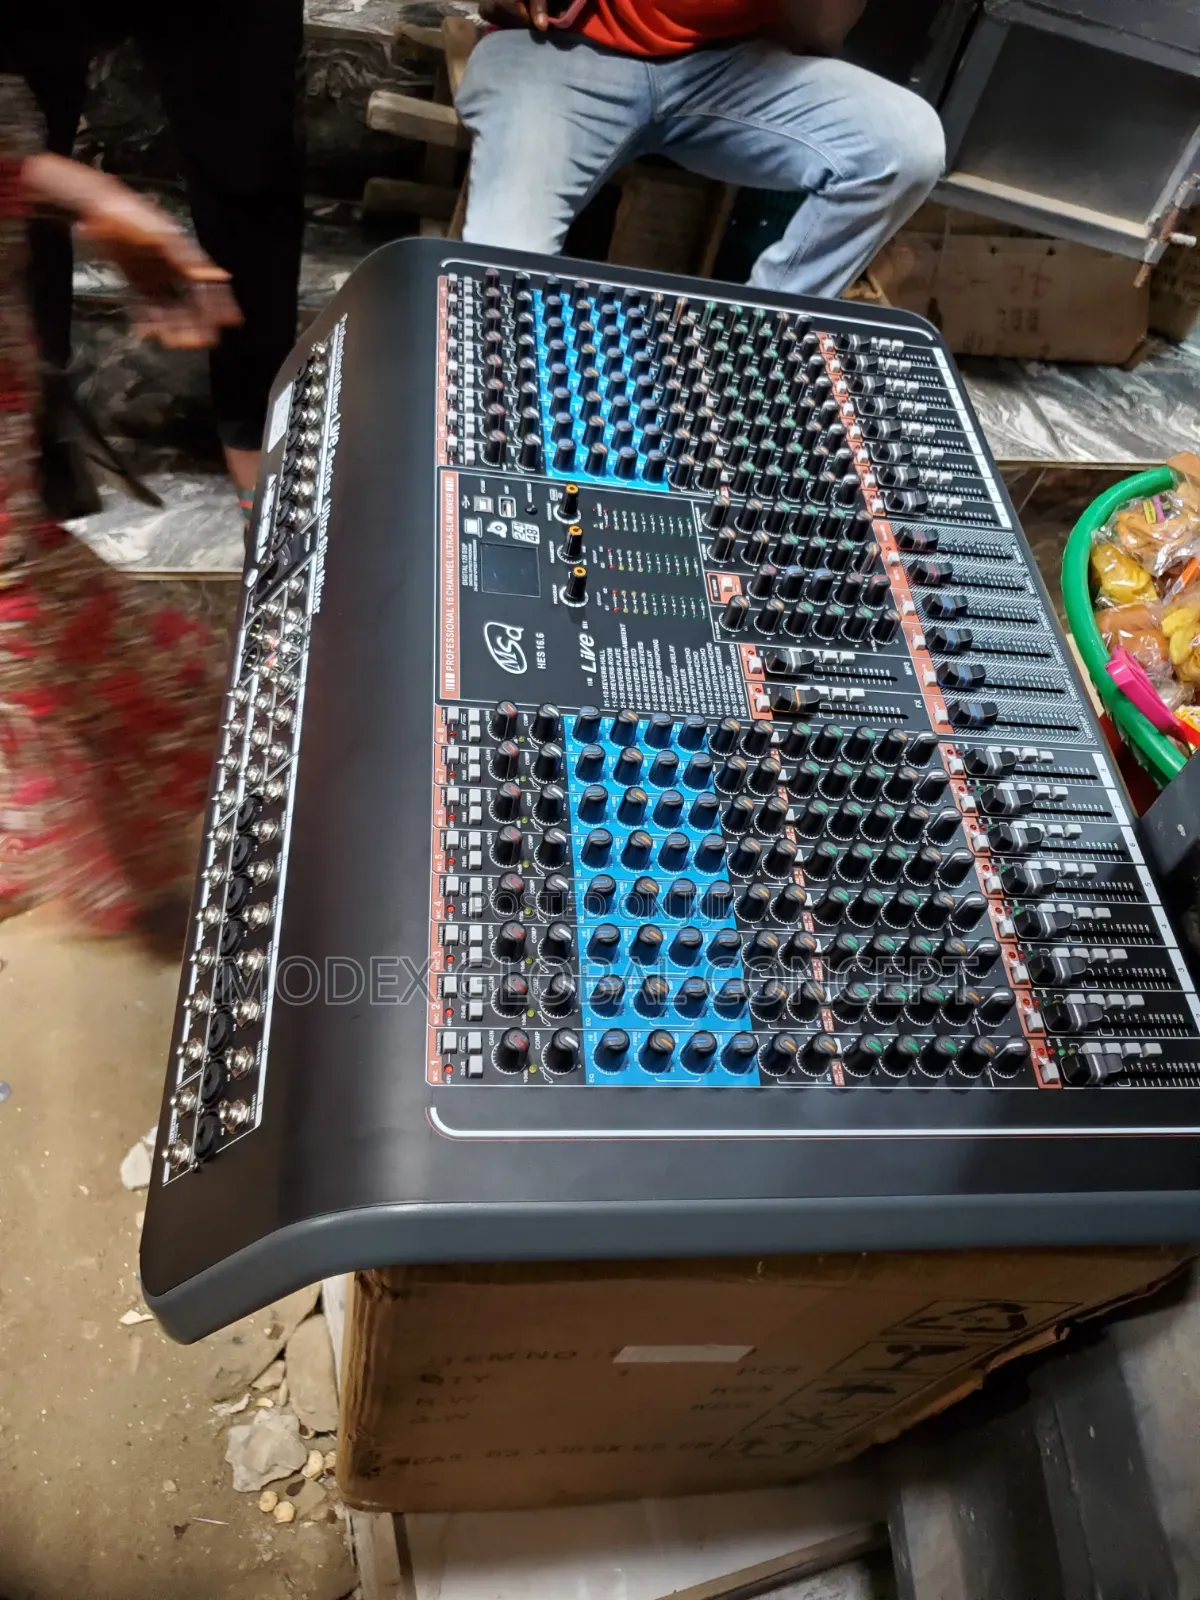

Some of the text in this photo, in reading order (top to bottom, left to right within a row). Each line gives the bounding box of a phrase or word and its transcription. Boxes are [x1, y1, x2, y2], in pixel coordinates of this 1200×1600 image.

[334, 313, 348, 384] Professional
[331, 382, 341, 416] Mixer
[514, 526, 525, 539] 24
[527, 529, 538, 542] 48
[312, 569, 325, 614] Mixer
[445, 493, 455, 671] PROFESSIONAL 16 CHANNEL ULTRA-SLIM MIXER
[1039, 611, 1049, 630] GROUP
[536, 632, 546, 669] HES 16.6
[715, 646, 724, 674] CHANGER
[1052, 644, 1063, 665] GROUP
[607, 647, 618, 707] 11-20:REVERB-ROOM
[904, 662, 912, 675] MP3
[1065, 678, 1078, 701] GROUP
[914, 699, 922, 708] FX
[1080, 715, 1093, 739] GROUP
[585, 1018, 591, 1026] EQ
[589, 1074, 595, 1082] EQ
